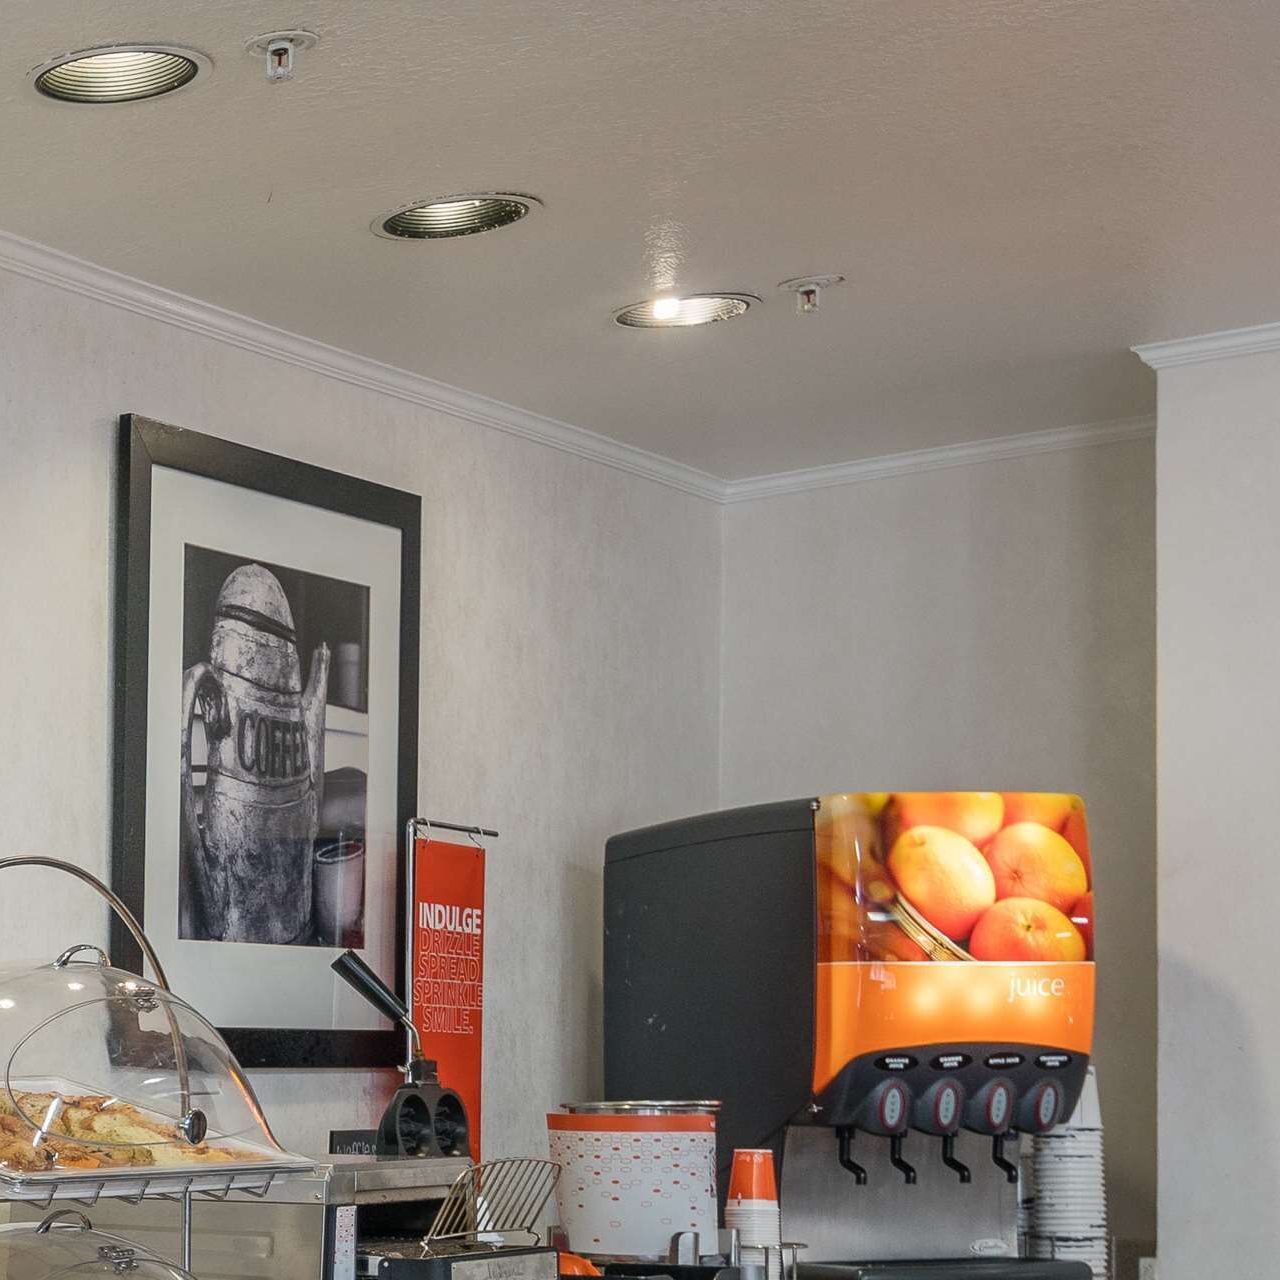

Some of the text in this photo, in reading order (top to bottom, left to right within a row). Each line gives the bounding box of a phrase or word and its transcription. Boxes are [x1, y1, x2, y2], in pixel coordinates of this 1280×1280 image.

[419, 902, 481, 935] INDULGE
[421, 928, 480, 959] DRIZZLE
[418, 952, 479, 983] SPREAD
[414, 978, 483, 1009] SPRINKLE
[422, 1005, 474, 1034] SMILE.
